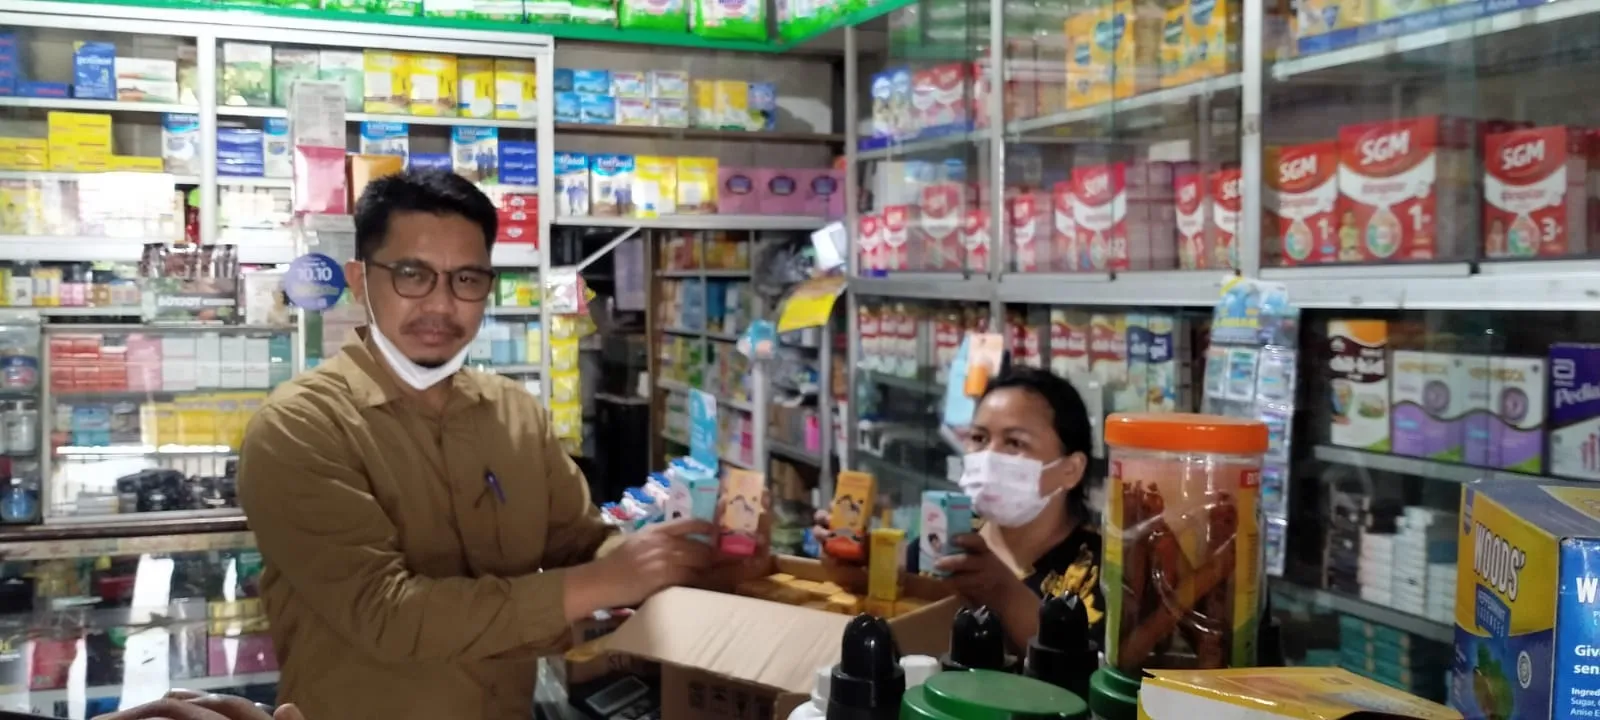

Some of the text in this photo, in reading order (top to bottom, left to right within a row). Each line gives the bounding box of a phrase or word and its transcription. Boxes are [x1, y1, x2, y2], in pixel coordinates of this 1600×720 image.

[1359, 129, 1411, 167] SGM
[1500, 138, 1545, 171] SGM
[1279, 153, 1318, 184] SGM
[1573, 664, 1600, 675] sen
